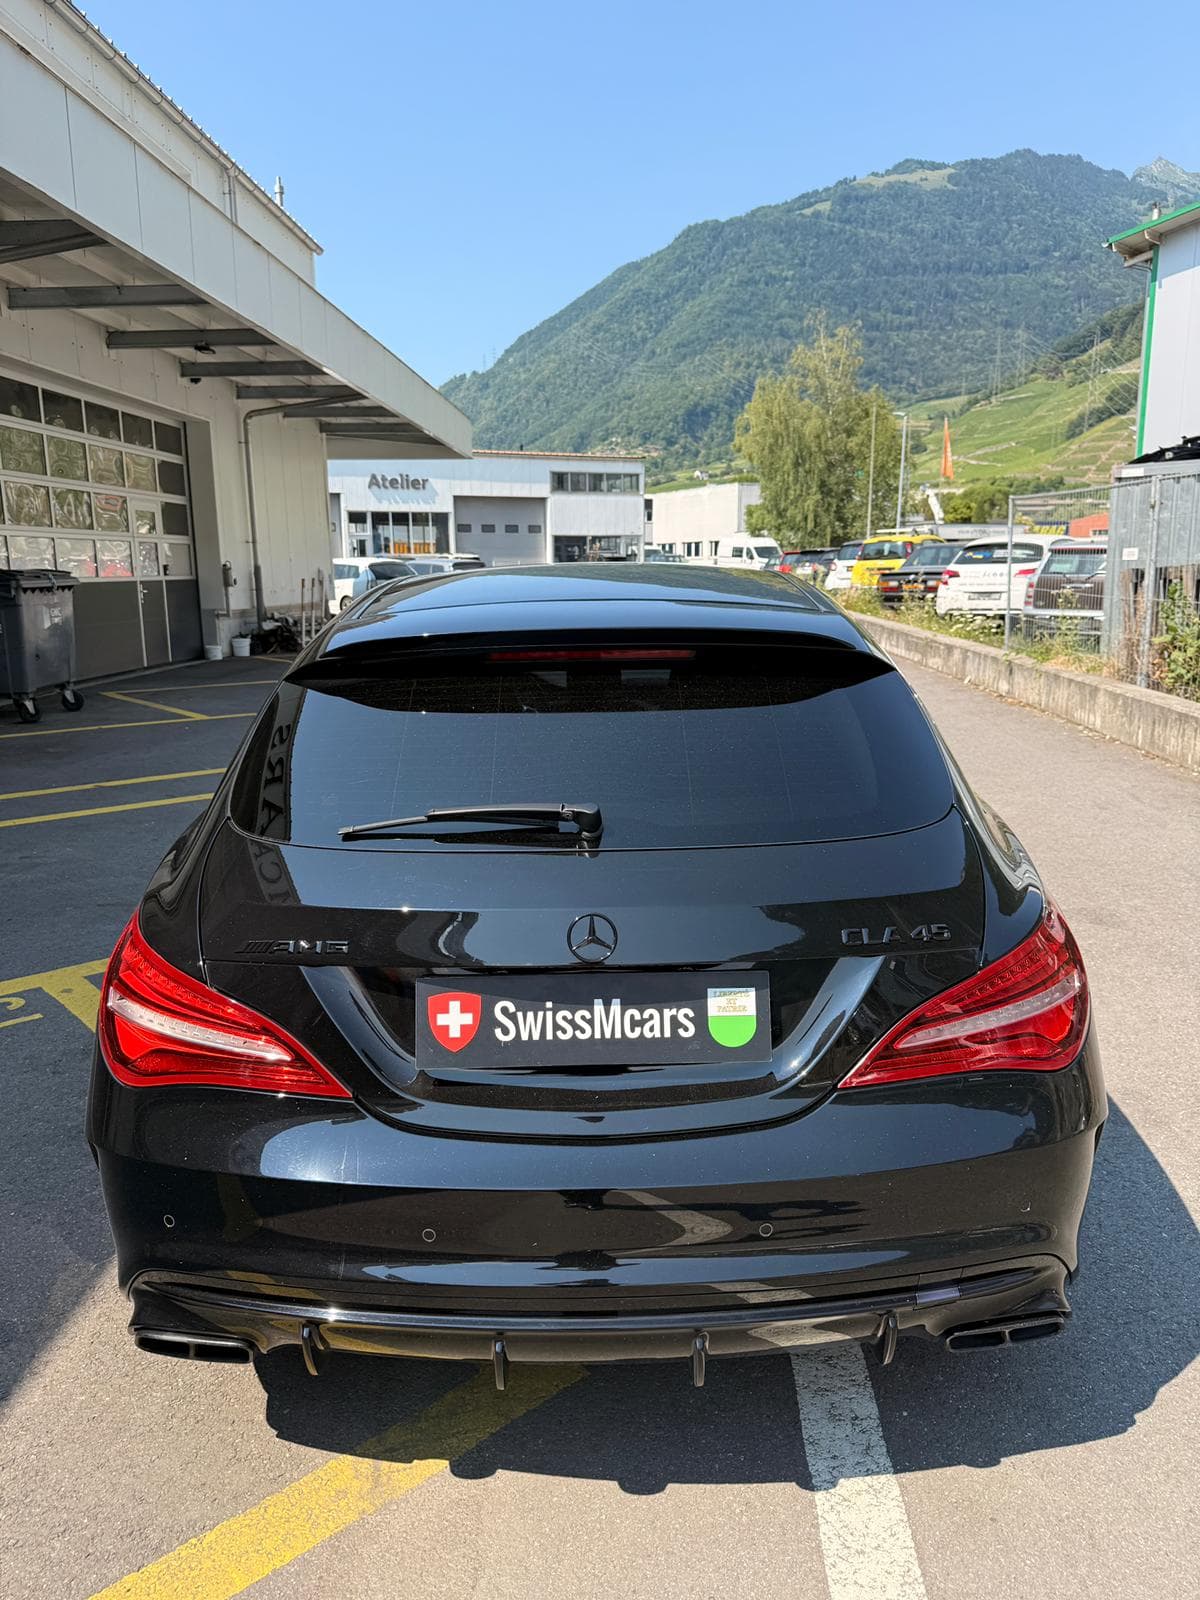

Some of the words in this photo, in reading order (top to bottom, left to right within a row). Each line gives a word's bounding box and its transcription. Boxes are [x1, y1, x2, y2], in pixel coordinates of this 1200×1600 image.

[367, 473, 429, 490] Atelier
[841, 926, 901, 945] CLA
[910, 923, 952, 942] 45
[494, 998, 696, 1042] SwissMcars
